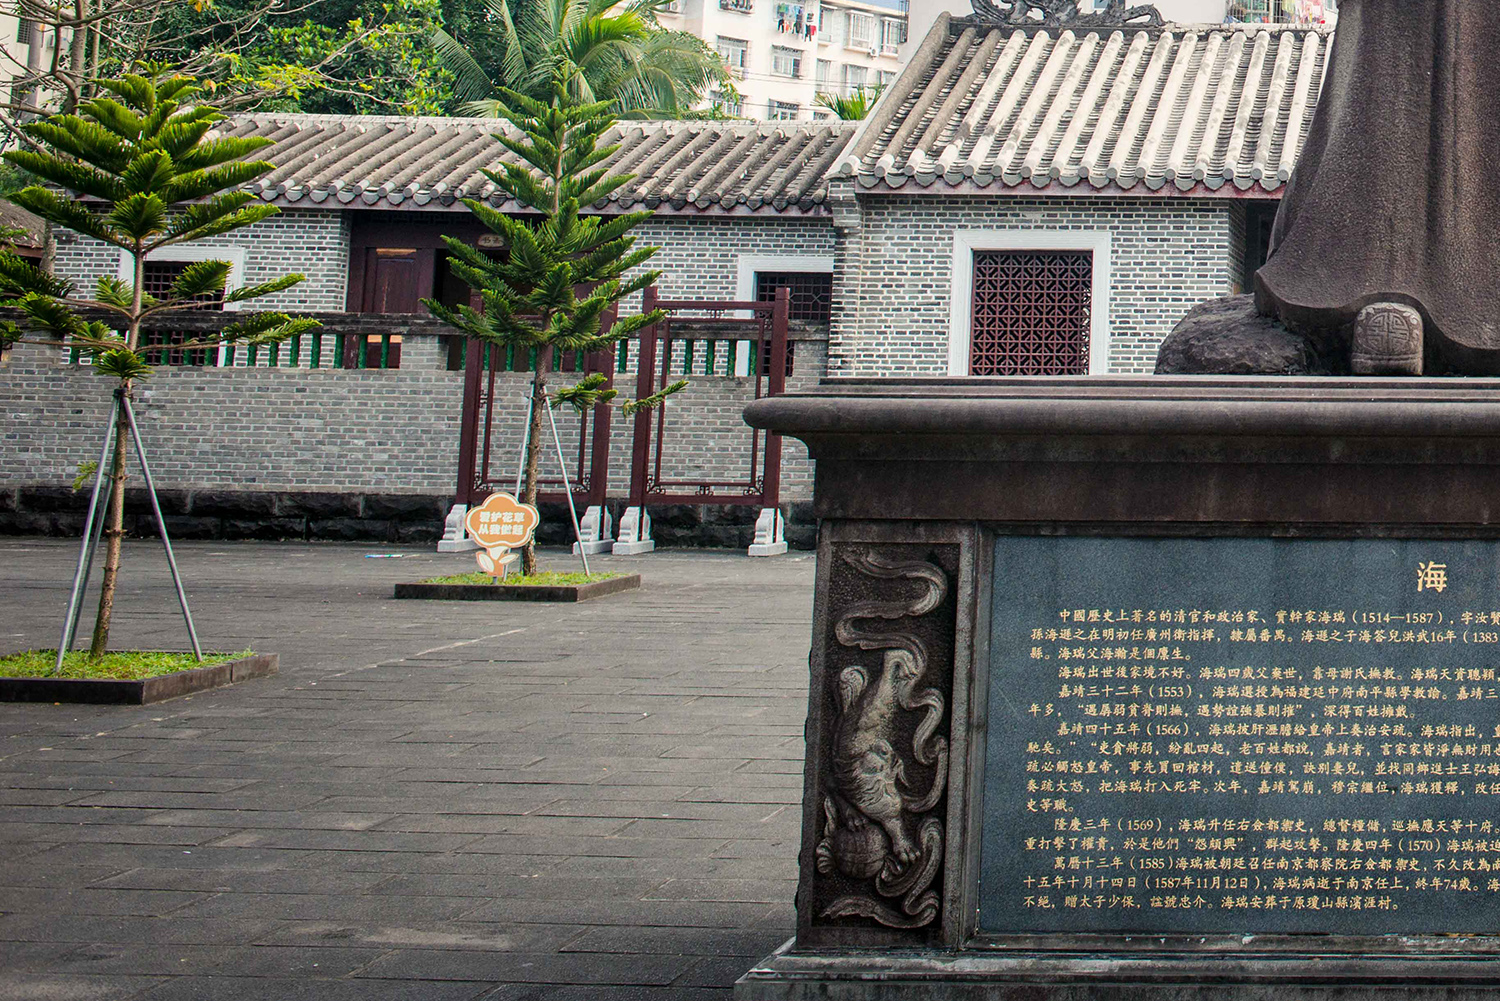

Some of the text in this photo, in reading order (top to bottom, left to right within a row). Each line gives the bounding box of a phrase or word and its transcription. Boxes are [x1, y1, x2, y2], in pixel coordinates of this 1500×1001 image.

[480, 511, 525, 523] 爱护花草
[478, 523, 524, 536] 从我做起
[1416, 560, 1448, 593] 海
[1026, 798, 1074, 813] 史等職。
